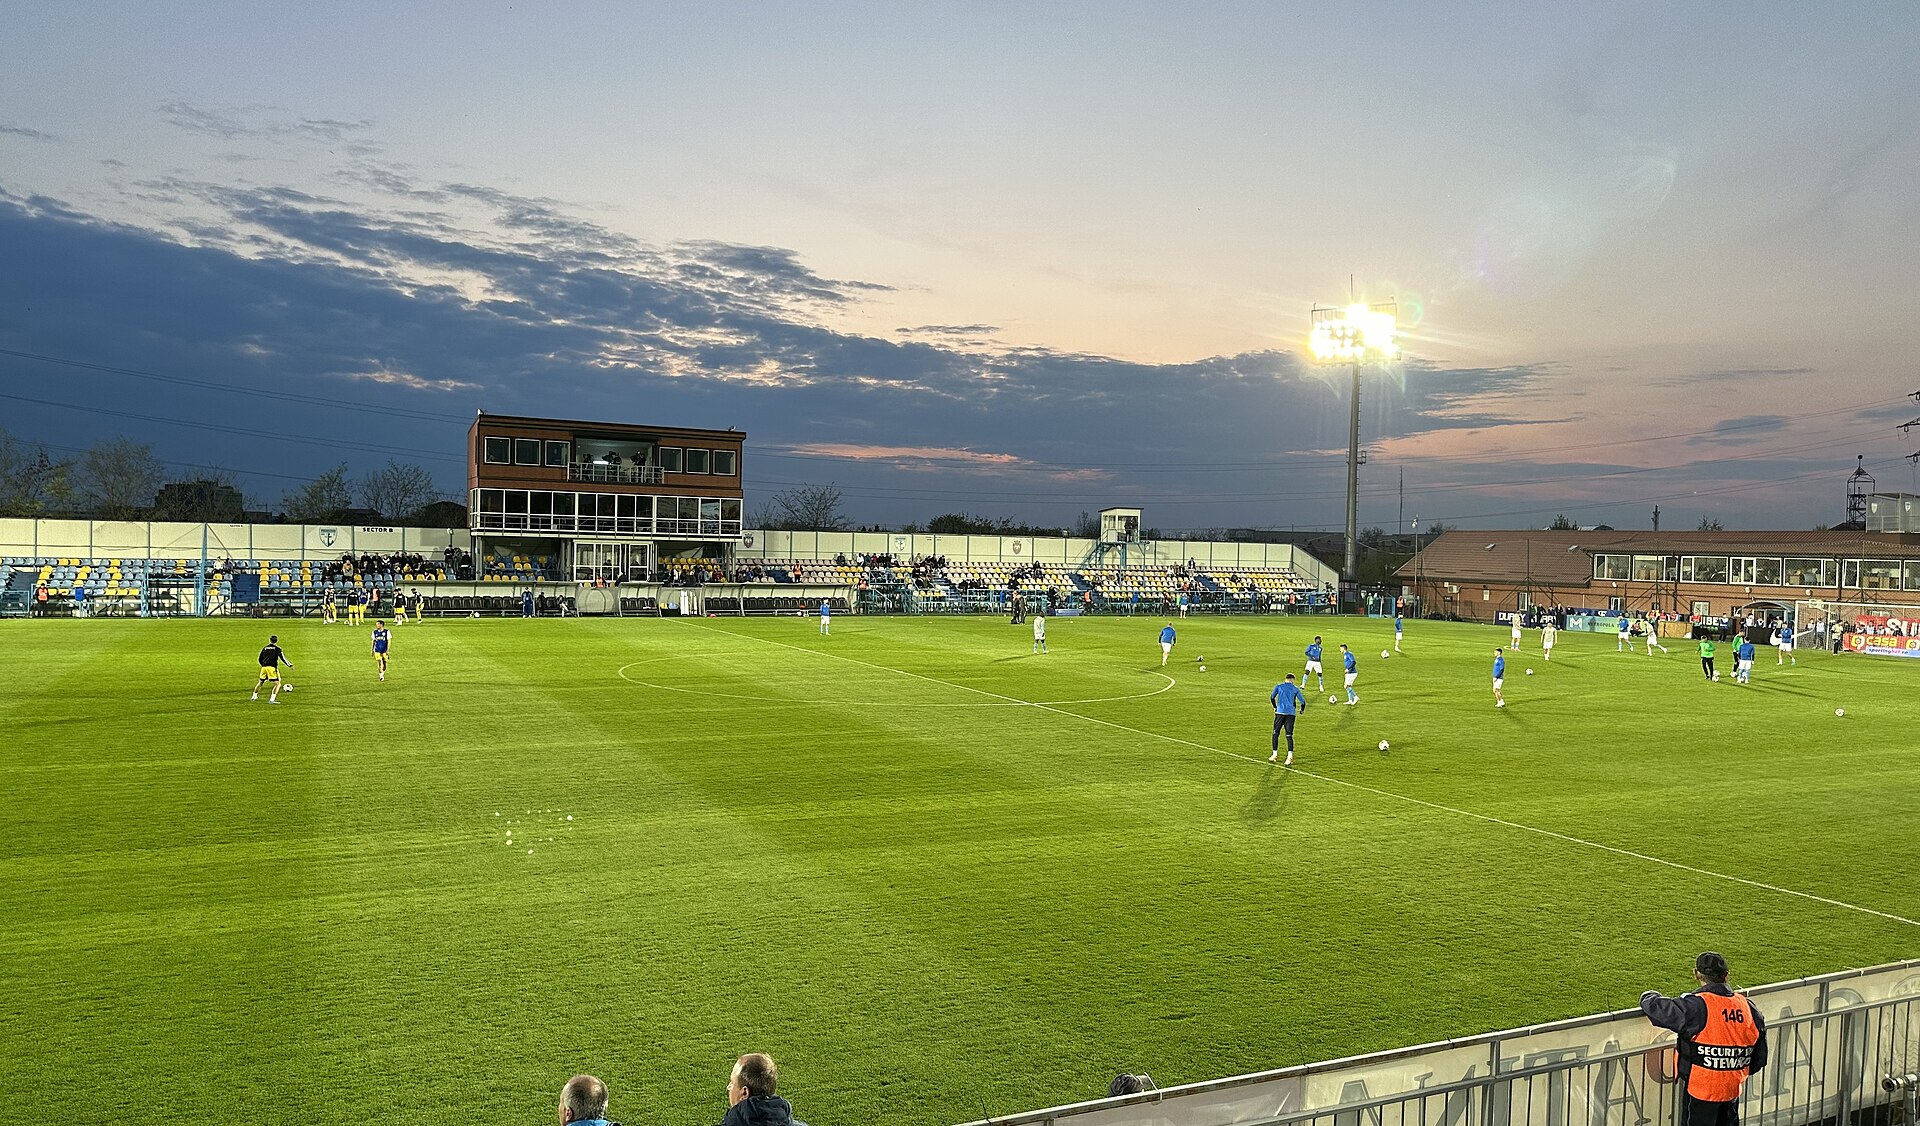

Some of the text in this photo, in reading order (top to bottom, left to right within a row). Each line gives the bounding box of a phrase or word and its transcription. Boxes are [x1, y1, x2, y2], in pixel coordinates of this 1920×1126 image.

[1498, 612, 1527, 622] DURY
[1866, 636, 1898, 647] casa
[1722, 1008, 1744, 1024] 146
[1697, 1045, 1744, 1057] SECURITY
